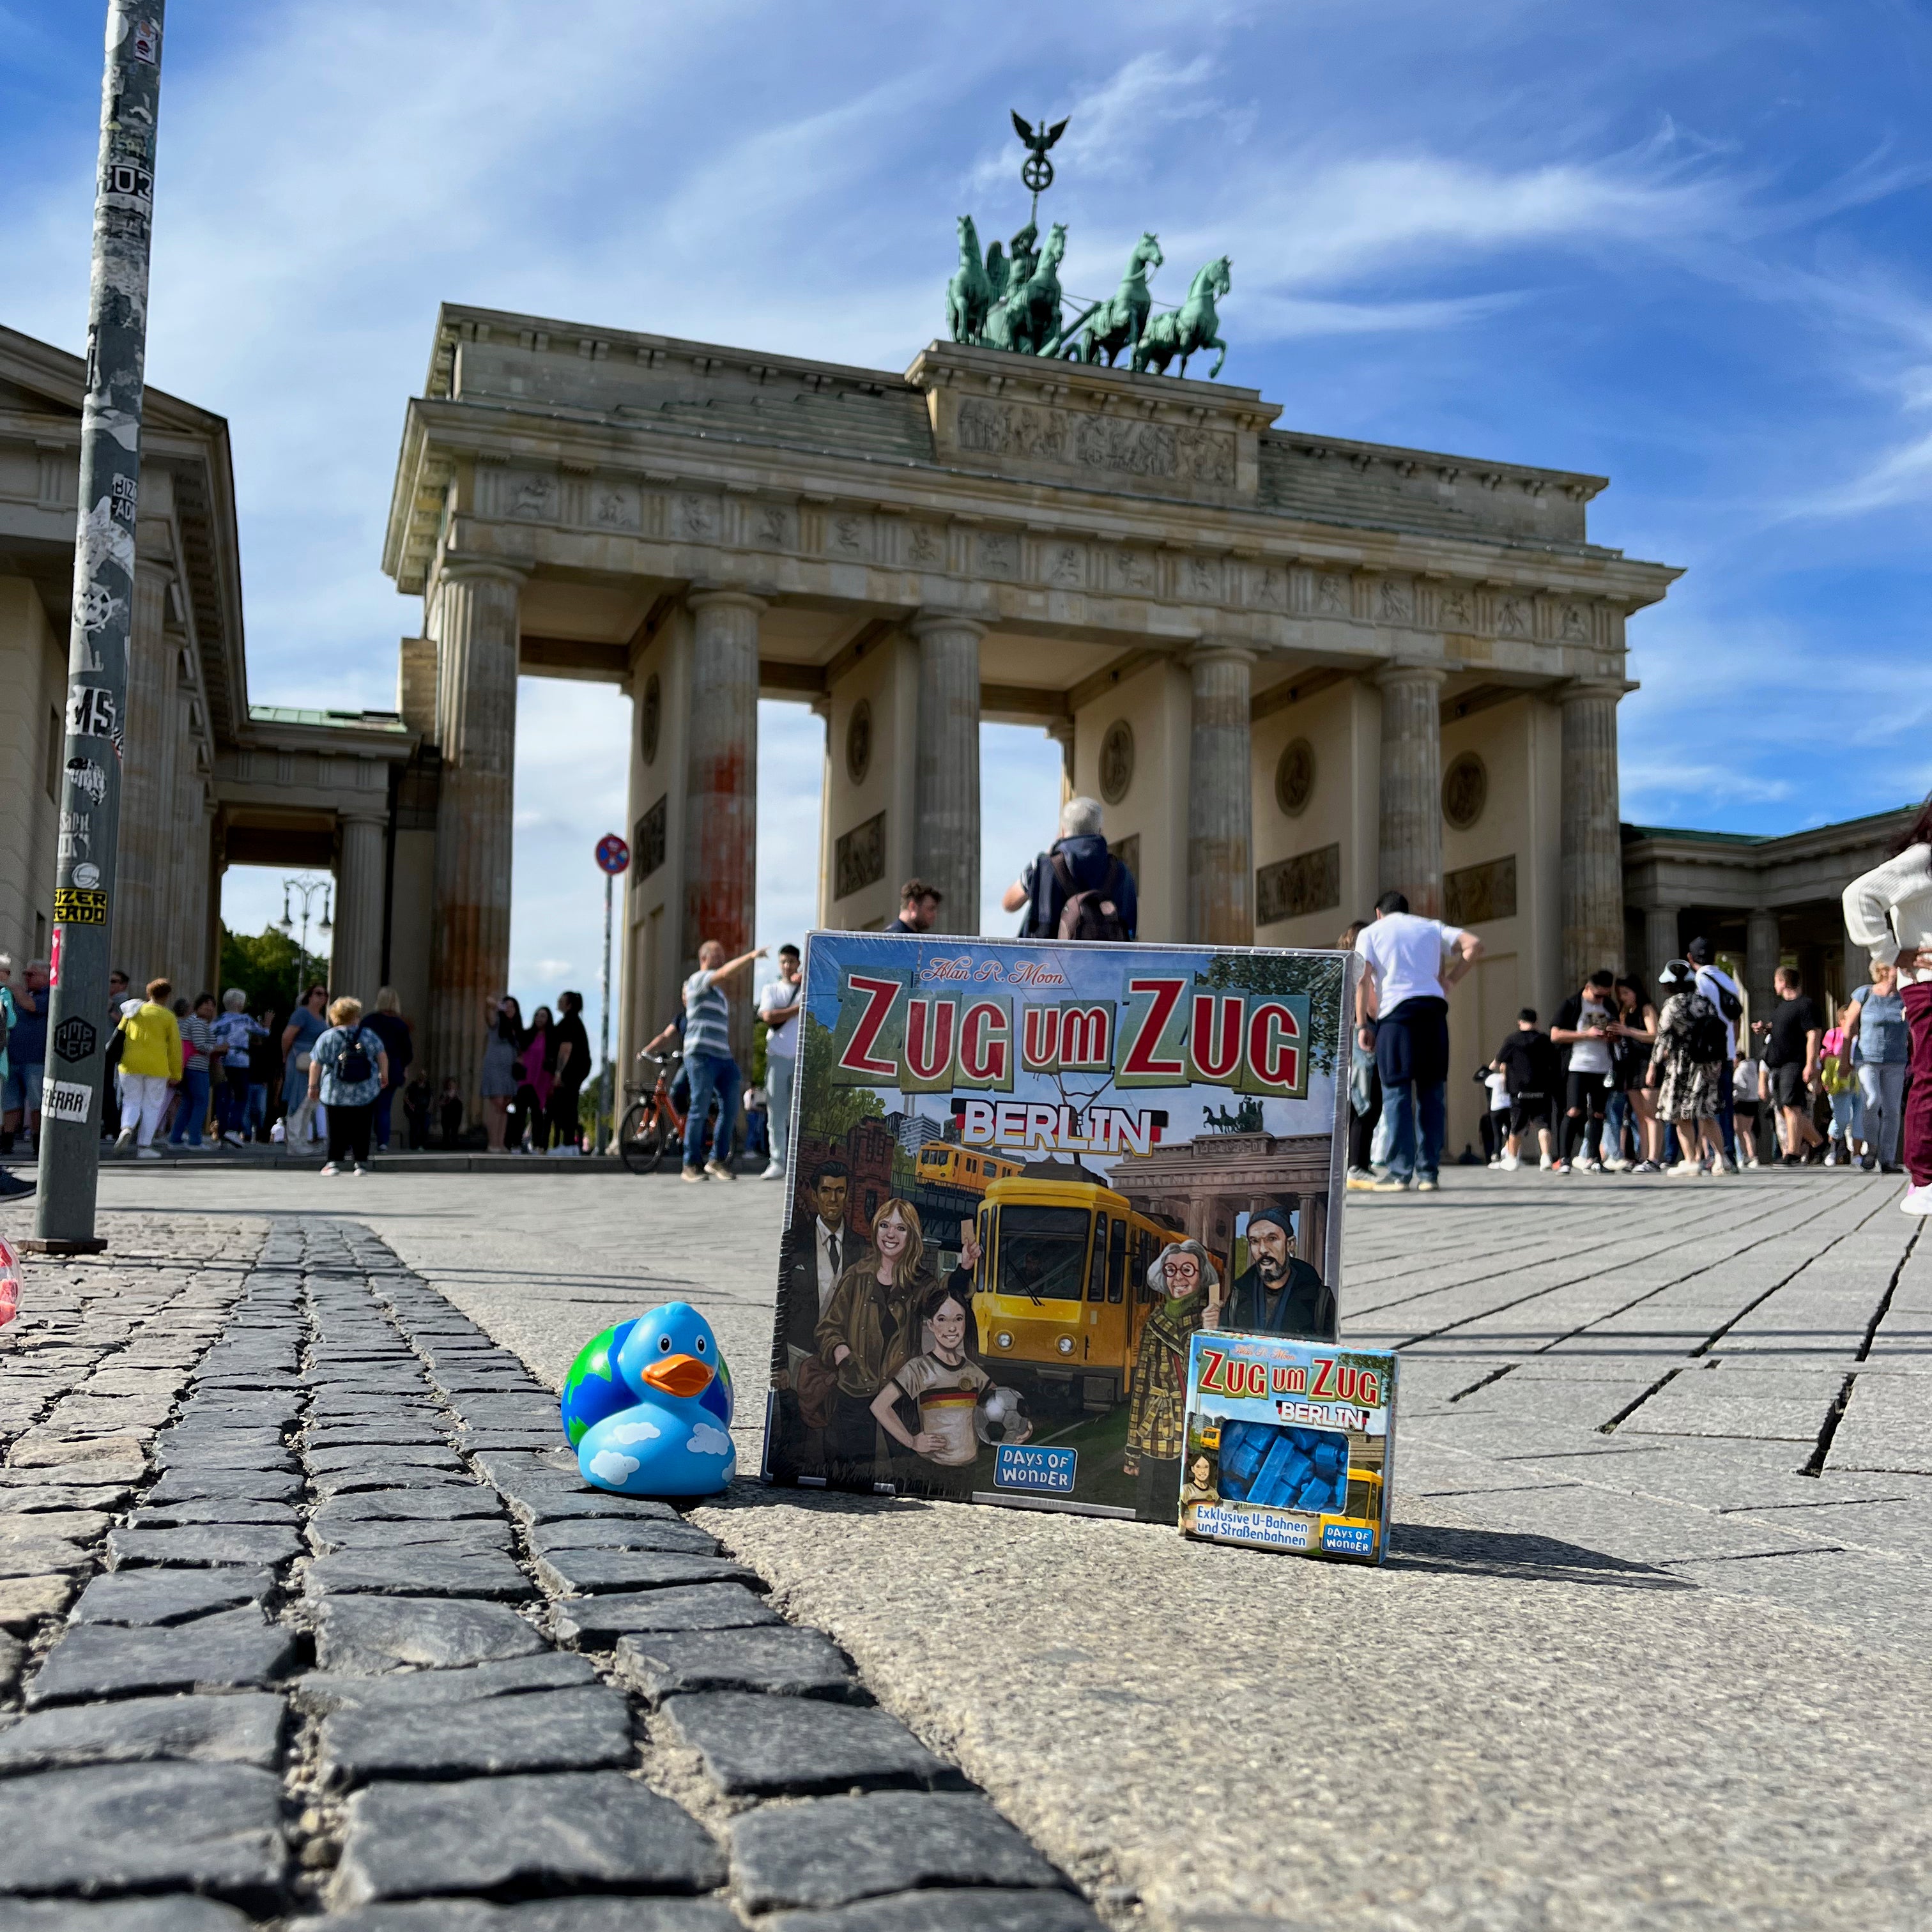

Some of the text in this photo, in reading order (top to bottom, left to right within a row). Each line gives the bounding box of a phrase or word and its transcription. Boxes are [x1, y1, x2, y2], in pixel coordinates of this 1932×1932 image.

[921, 956, 1066, 986] Alan R. Moon
[838, 974, 1008, 1081] ZUG
[1120, 977, 1300, 1091] ZUG
[962, 1100, 1153, 1155] BERLIN
[1270, 1348, 1296, 1361] Moon
[1200, 1349, 1267, 1396] ZUG
[1310, 1358, 1378, 1406] ZUG
[1280, 1401, 1363, 1430] BERLIN
[1048, 1453, 1069, 1468] OF
[1197, 1505, 1250, 1524] Exklusive
[1252, 1513, 1308, 1533] U-Bahnen
[1197, 1521, 1306, 1546] und Straßenbahnen
[1355, 1531, 1369, 1540] OF
